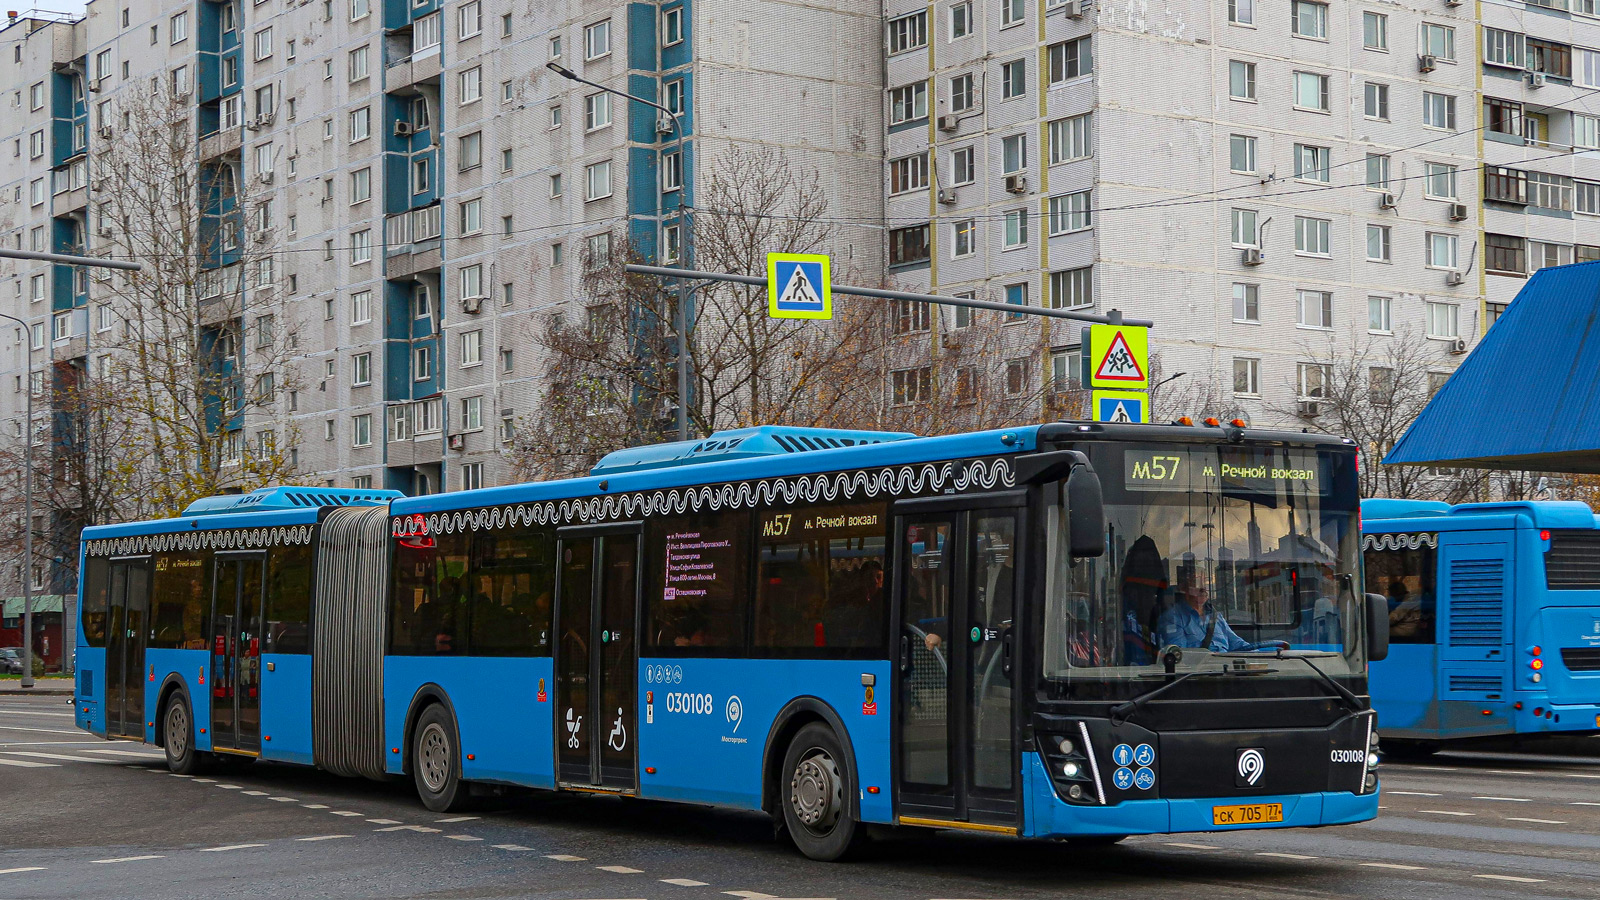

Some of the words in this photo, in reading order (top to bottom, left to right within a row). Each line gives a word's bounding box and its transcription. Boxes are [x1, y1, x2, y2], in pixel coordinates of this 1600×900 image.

[1132, 456, 1180, 480] м57
[1203, 466, 1216, 477] м.
[1221, 464, 1266, 478] Речной
[1271, 467, 1314, 480] вокзал
[763, 514, 792, 537] м57
[804, 520, 813, 530] м.
[816, 515, 846, 529] Речной
[848, 515, 878, 527] вокзал
[666, 692, 713, 715] 030108
[1330, 749, 1364, 763] 030108
[1239, 806, 1262, 821] 705
[1267, 805, 1279, 816] 77
